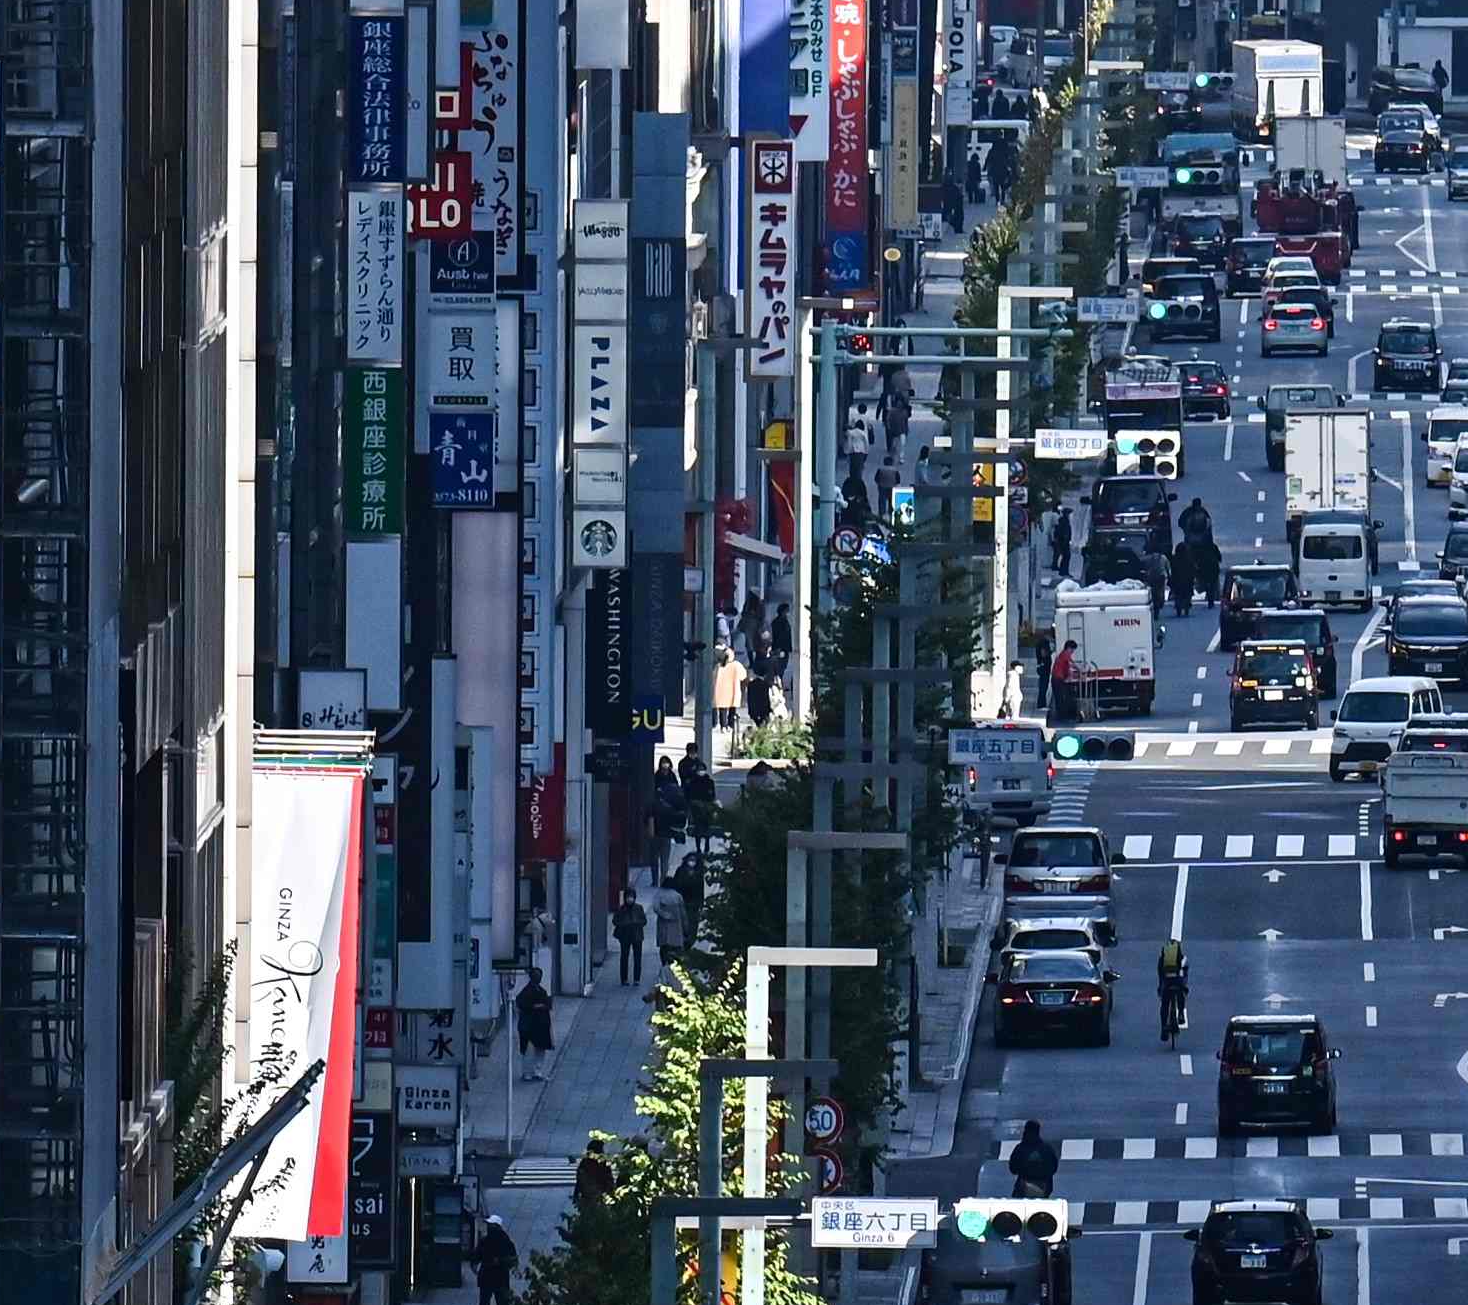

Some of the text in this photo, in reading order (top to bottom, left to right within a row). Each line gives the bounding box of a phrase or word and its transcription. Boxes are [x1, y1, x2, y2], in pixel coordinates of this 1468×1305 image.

[949, 16, 965, 74] POLA
[361, 21, 393, 178] 銀座総合法律事務所
[490, 169, 515, 256] うなぎ
[355, 200, 373, 352] レディスクリニック
[377, 200, 397, 344] 銀座すずらん通り
[758, 202, 790, 365] キムラヤのパン
[448, 327, 475, 382] 買取
[591, 336, 611, 432] PLAZA
[361, 370, 387, 531] 西銀座診療所
[434, 429, 488, 483] 青山
[607, 567, 622, 704] WASHINGTON
[1113, 618, 1141, 628] KIRIN
[955, 739, 1035, 754] 銀座五丁目
[277, 887, 293, 942] GINZA
[404, 1086, 451, 1098] Ginza
[404, 1099, 452, 1111] Karen
[810, 1110, 834, 1133] 50
[821, 1213, 928, 1232] 銀座六丁目
[852, 1233, 884, 1245] Ginza
